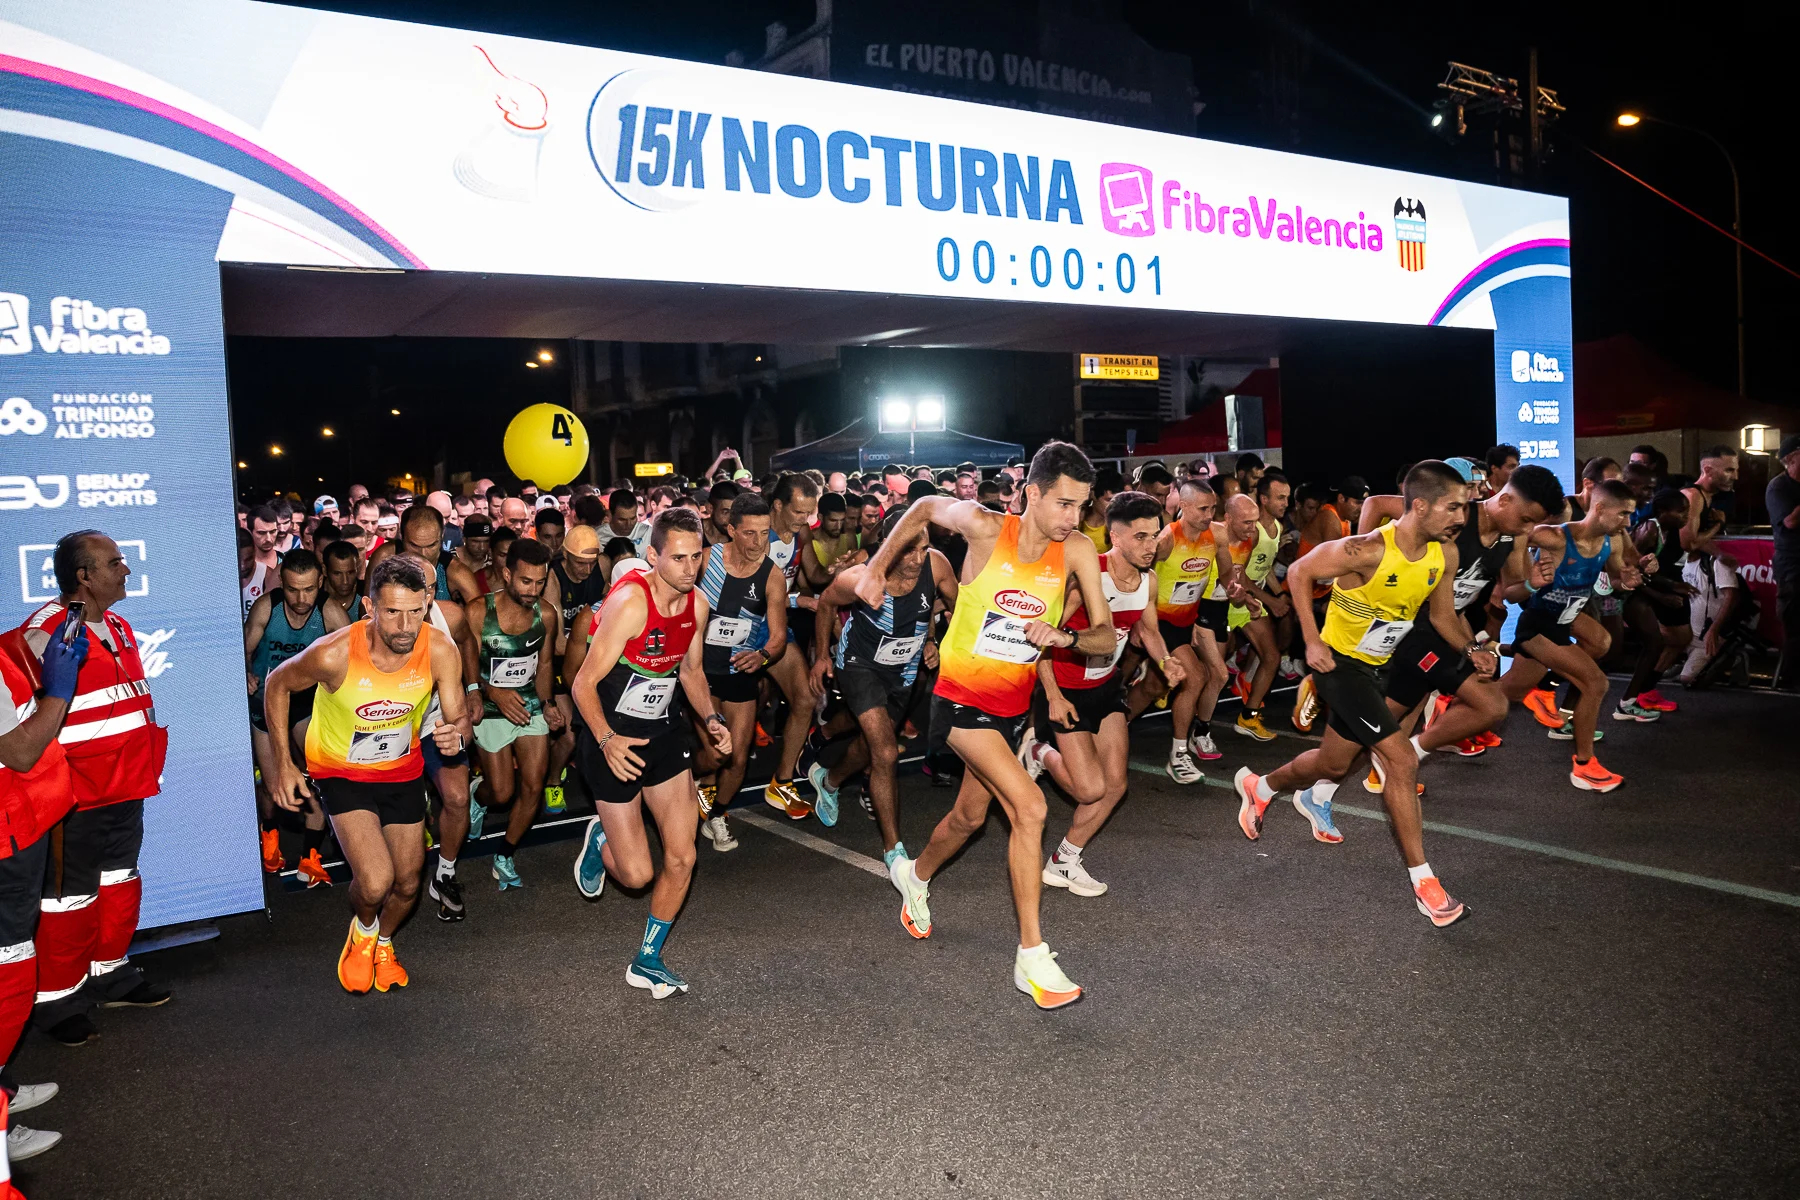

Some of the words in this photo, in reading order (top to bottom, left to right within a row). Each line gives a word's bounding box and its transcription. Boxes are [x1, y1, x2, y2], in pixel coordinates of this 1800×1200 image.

[866, 44, 893, 69] EL
[900, 43, 996, 83] PUERTO
[1003, 52, 1153, 105] VALENCIA.com
[615, 103, 711, 189] 15K
[722, 116, 1083, 226] NOCTURNA
[936, 236, 1161, 296] 00:00:01
[33, 325, 171, 355] Valencia
[1103, 357, 1139, 366] TRANSIT
[1141, 358, 1153, 366] EN
[1104, 368, 1131, 376] TEMPS
[1133, 369, 1154, 377] REAL
[52, 392, 154, 404] FUNDACIÓN
[52, 406, 155, 423] TRINIDAD
[54, 422, 156, 439] ALFONSO
[78, 489, 158, 508] SPORTS
[999, 594, 1043, 613] Serrano
[718, 628, 735, 636] 161
[985, 632, 1007, 642] JOSE
[1007, 637, 1030, 647] IGNA
[1382, 636, 1397, 645] 99
[269, 640, 308, 654] CRESP
[891, 648, 912, 656] 604
[505, 668, 527, 677] 640
[642, 694, 664, 704] 107
[361, 705, 410, 717] Serrano
[379, 742, 388, 751] 8
